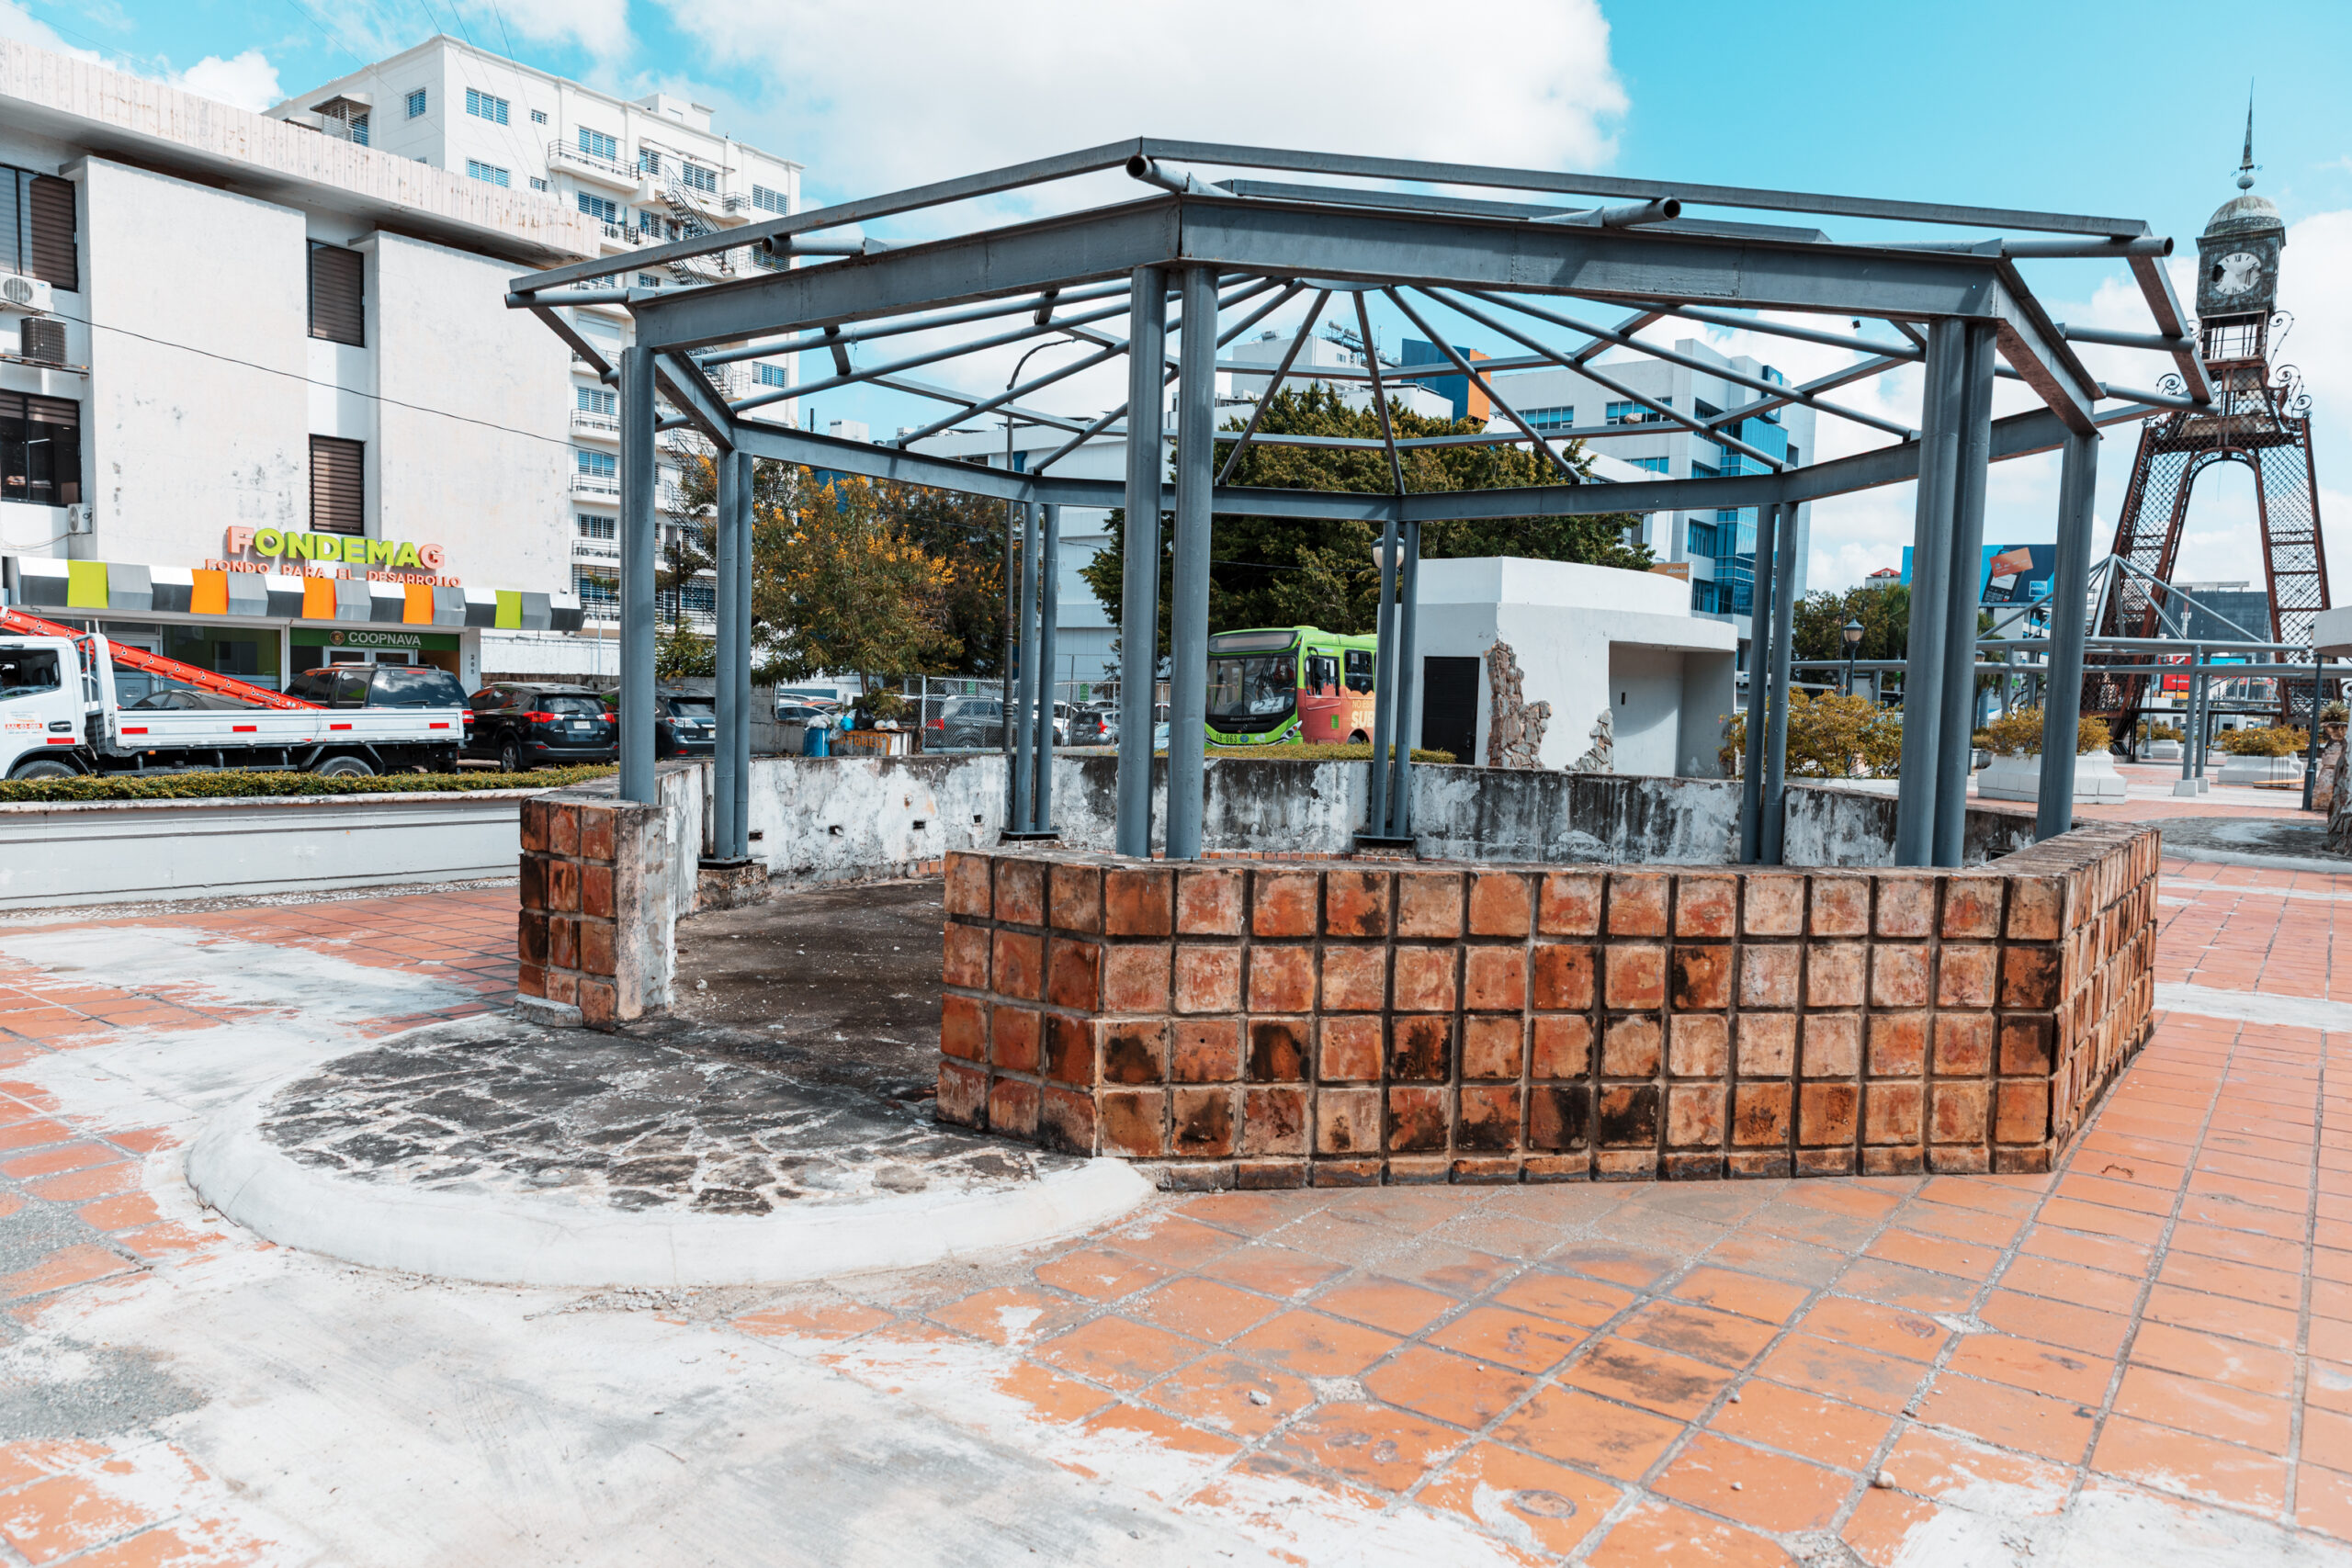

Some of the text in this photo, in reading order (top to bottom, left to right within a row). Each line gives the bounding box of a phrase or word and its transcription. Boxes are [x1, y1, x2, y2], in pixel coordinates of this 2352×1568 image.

[227, 525, 446, 570] FONDEMAG
[205, 558, 462, 588] FONDO PARA EL DESARROLLO
[348, 631, 422, 647] COOPNAVA
[1216, 733, 1238, 743] 16-063
